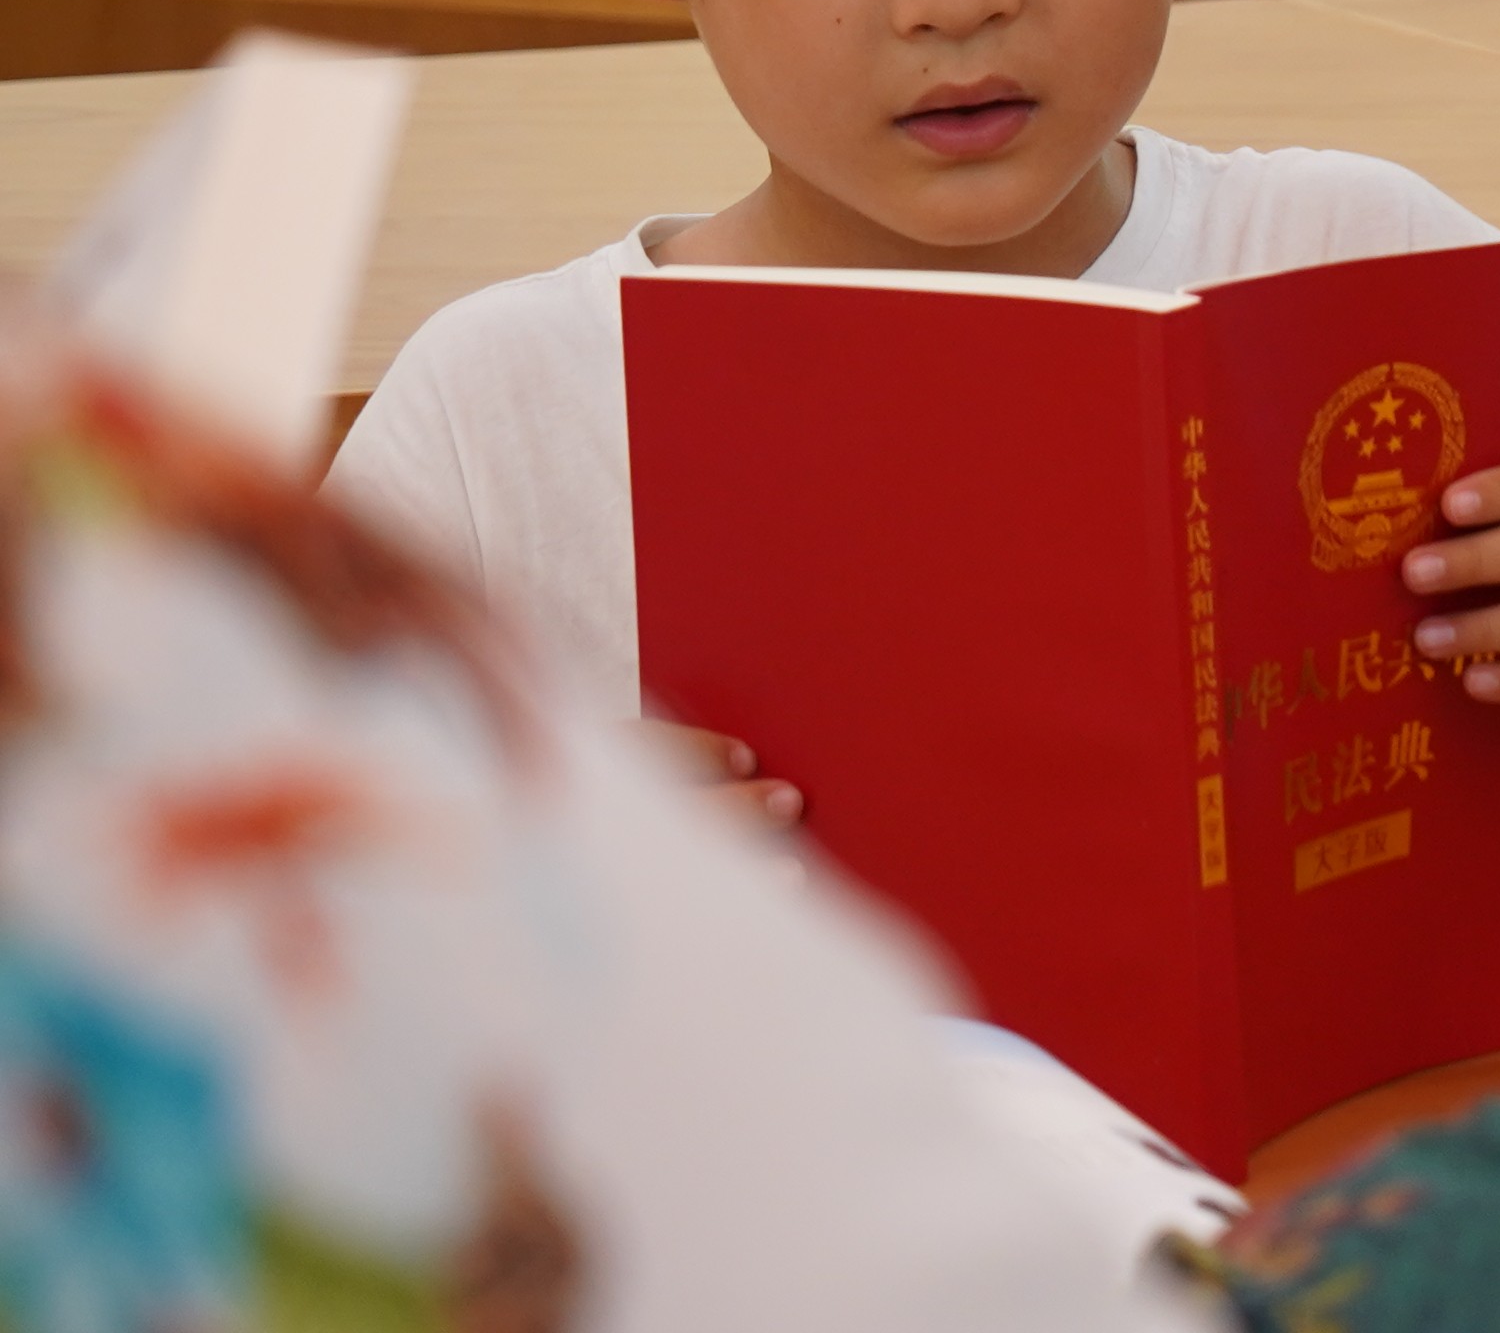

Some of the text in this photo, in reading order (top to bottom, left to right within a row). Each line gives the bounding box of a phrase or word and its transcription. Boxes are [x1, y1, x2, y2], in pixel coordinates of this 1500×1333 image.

[1181, 415, 1219, 761] 中华人民共和国民法典
[1283, 720, 1435, 825] 民法典
[1312, 827, 1388, 880] 大字版
